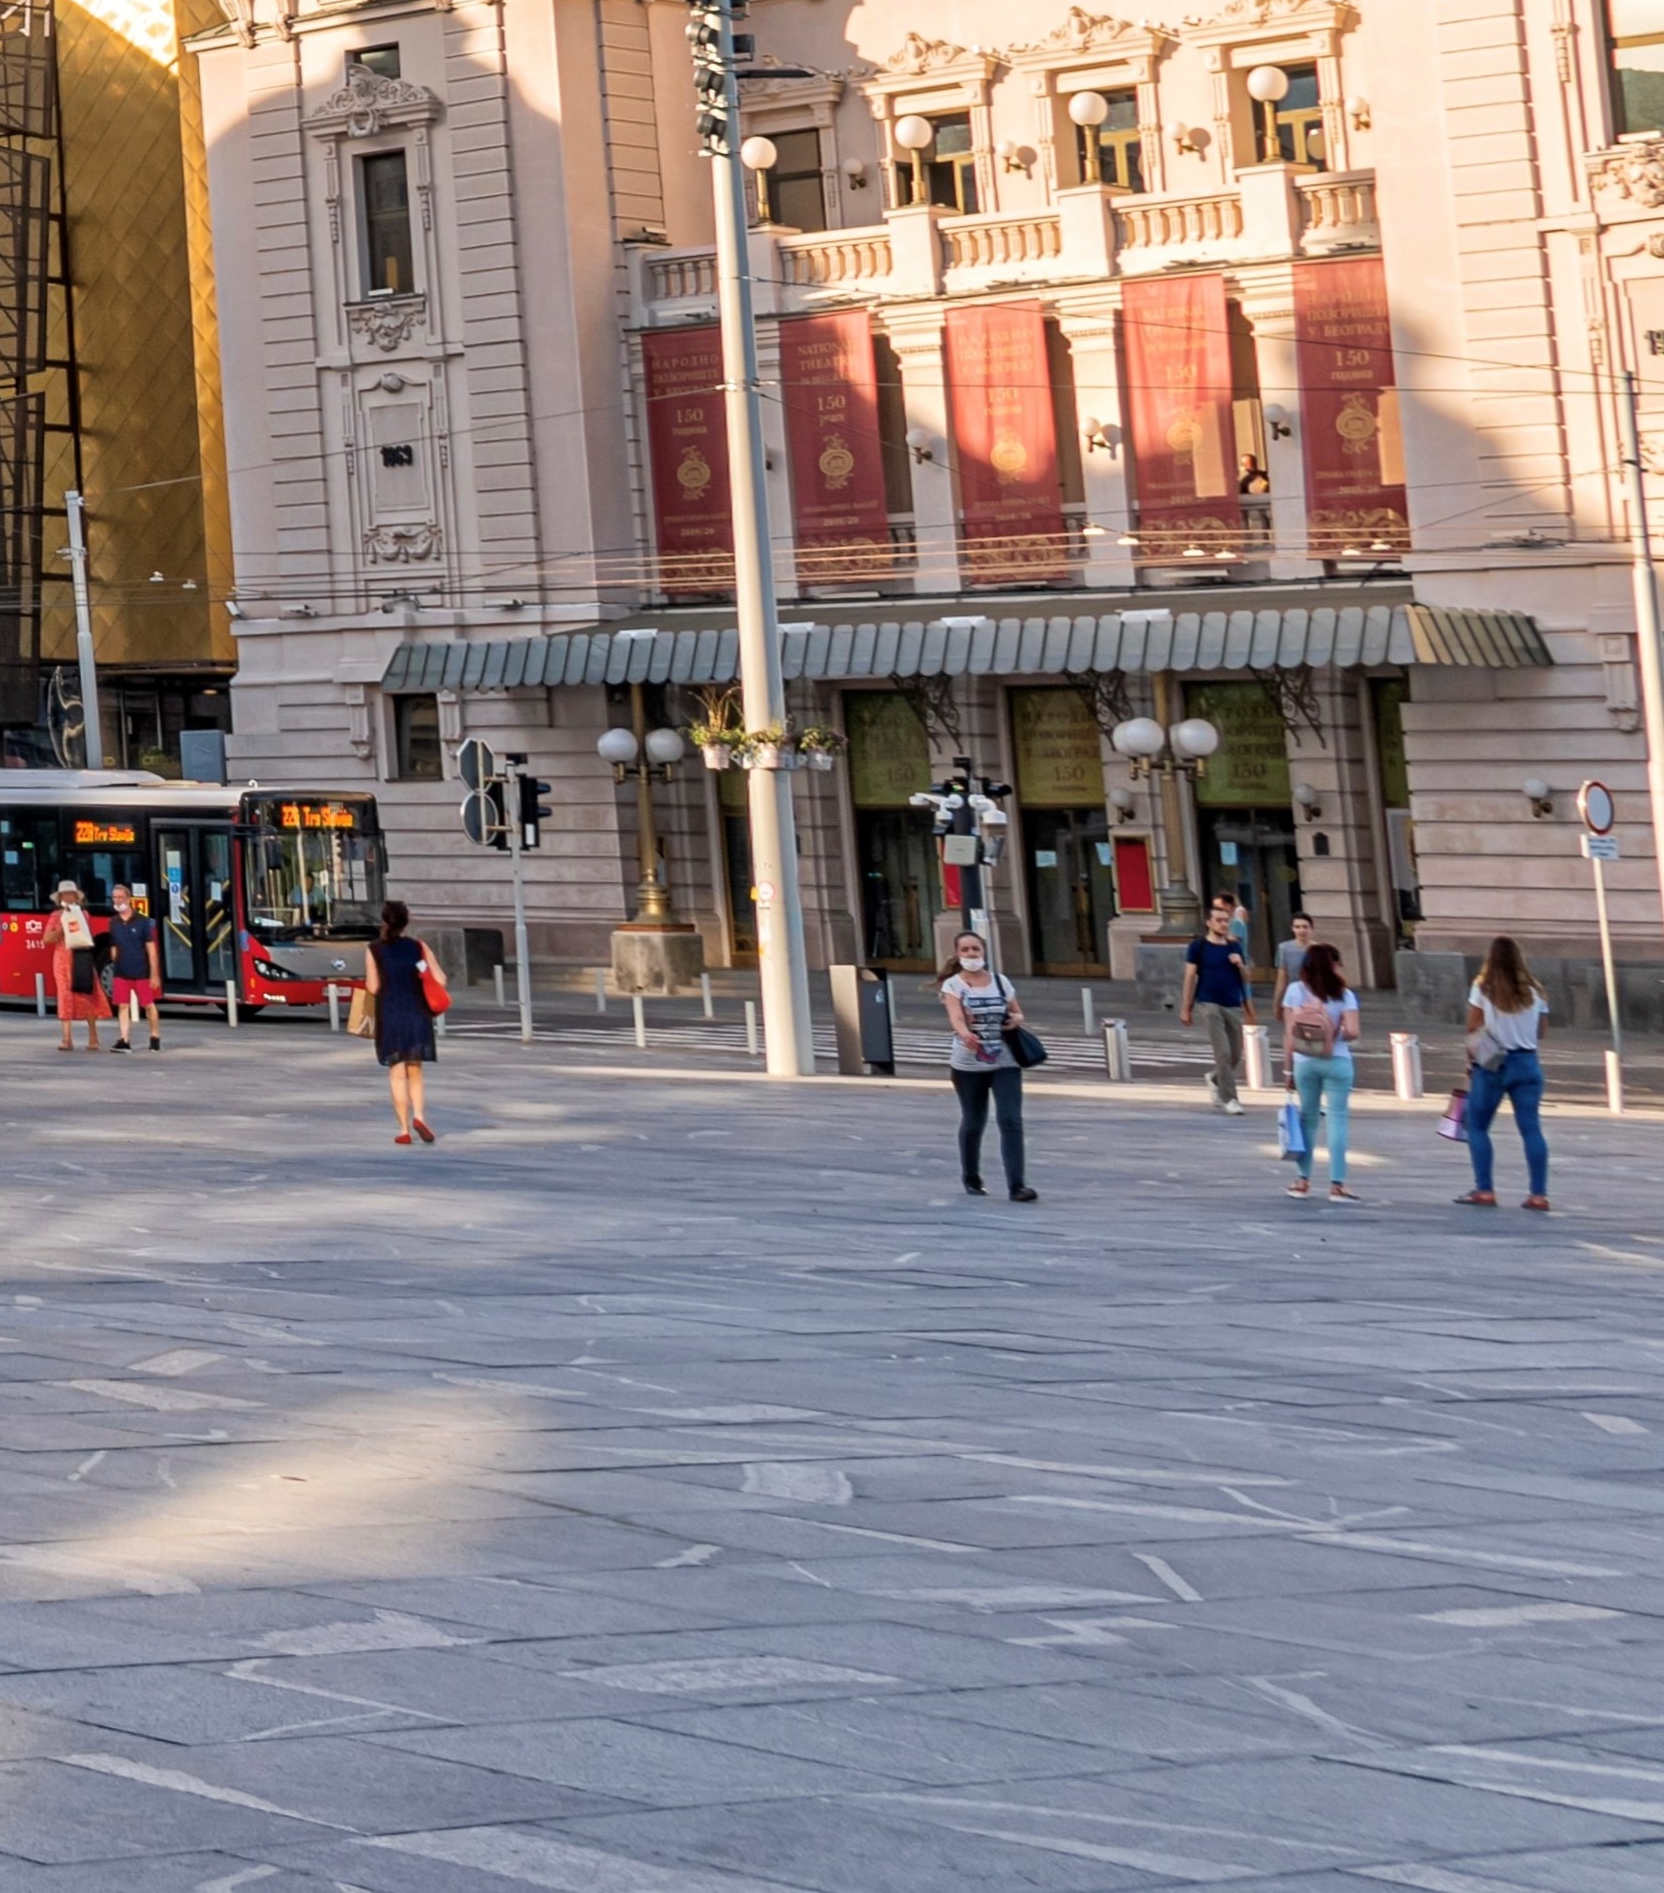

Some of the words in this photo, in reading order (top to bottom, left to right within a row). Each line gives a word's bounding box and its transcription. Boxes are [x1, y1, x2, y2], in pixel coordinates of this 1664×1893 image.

[1335, 350, 1369, 367] 150
[817, 395, 846, 411] 150
[676, 408, 704, 423] 150
